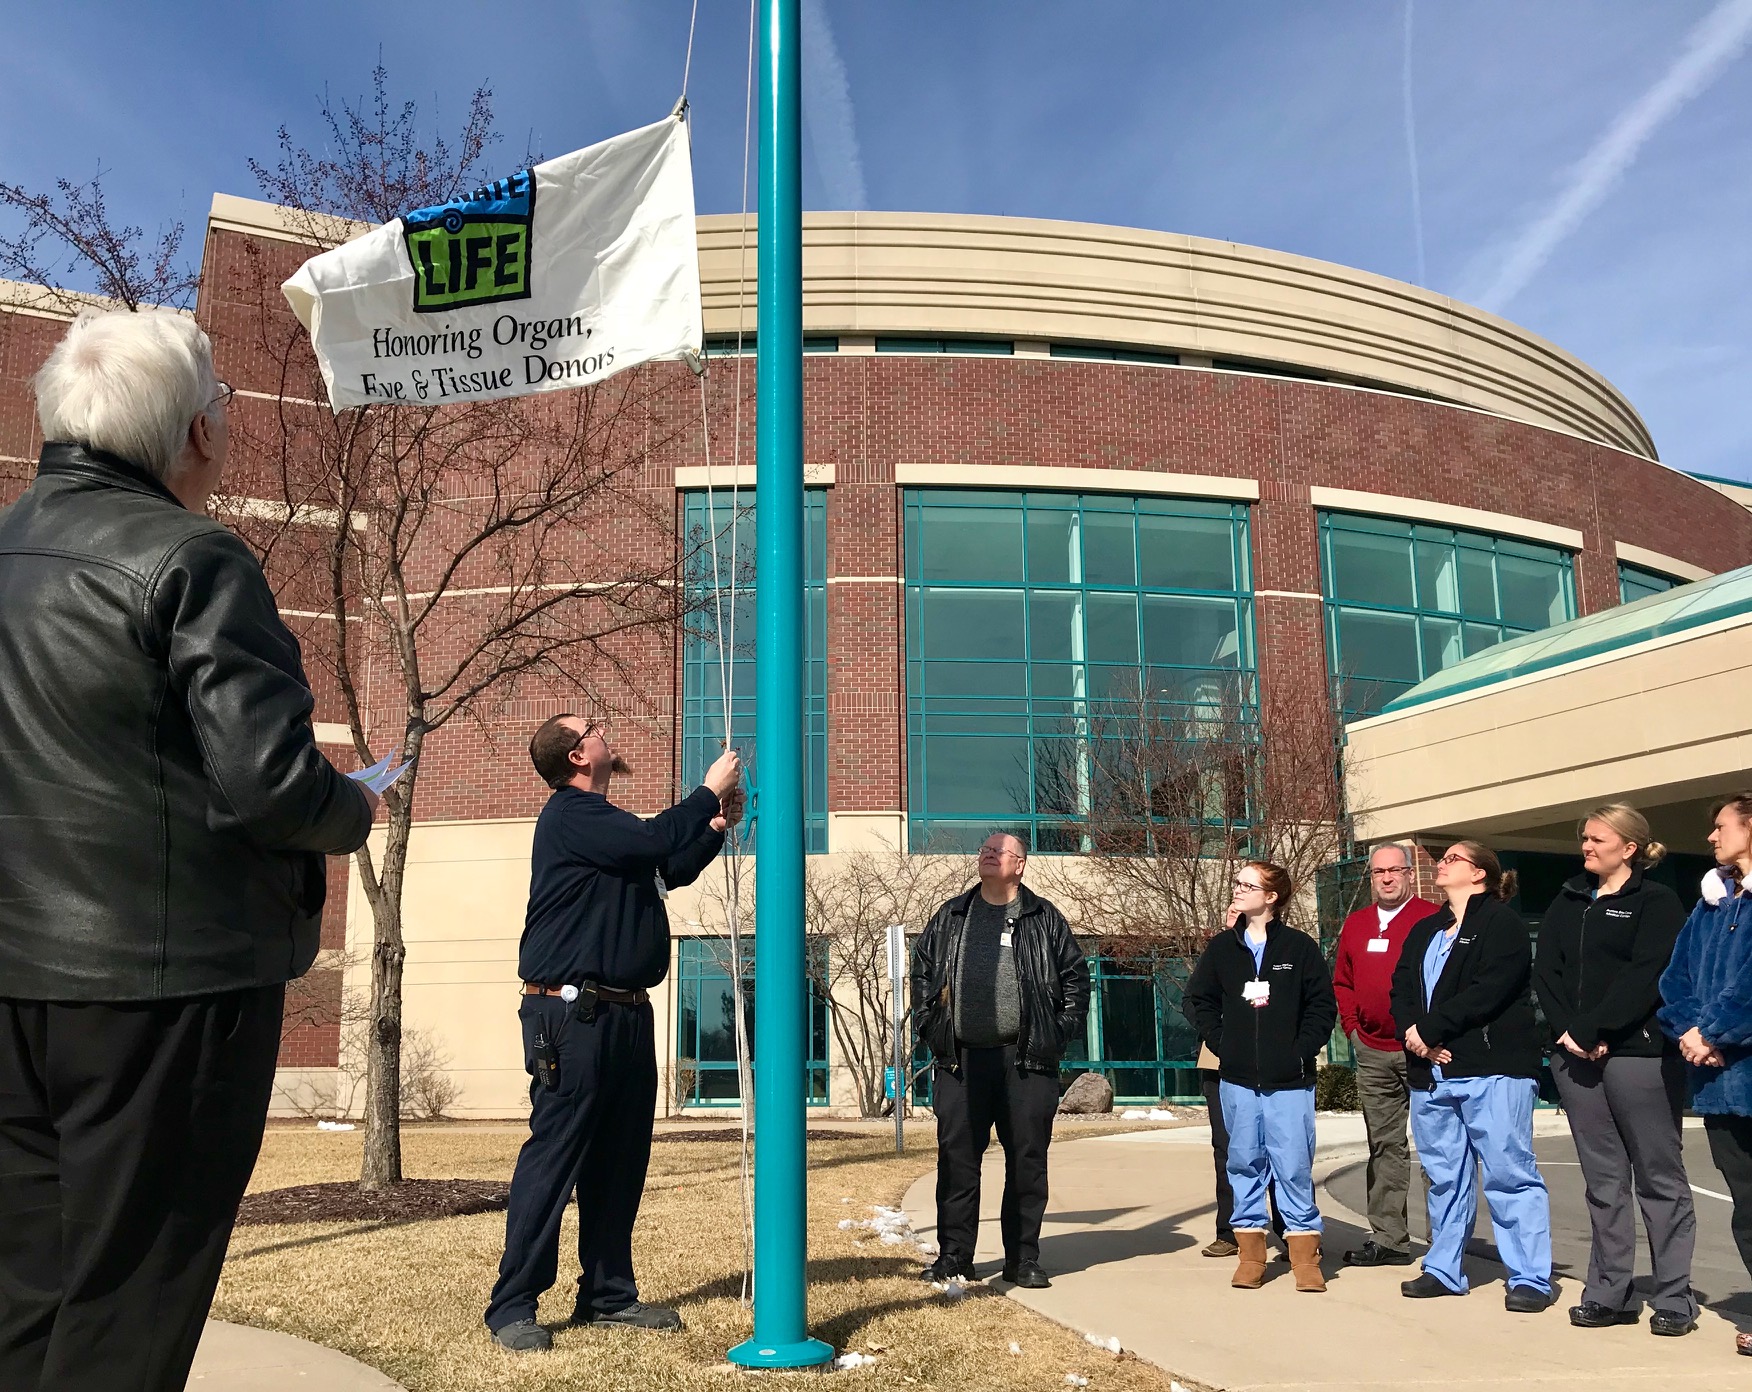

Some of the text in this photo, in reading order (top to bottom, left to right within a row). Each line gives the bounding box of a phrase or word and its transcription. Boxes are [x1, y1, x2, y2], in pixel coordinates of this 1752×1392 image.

[419, 234, 519, 296] LIFE
[372, 315, 593, 359] Honoring Organ,
[412, 369, 429, 400] &
[431, 366, 514, 397] Tissue
[523, 346, 615, 385] Donors
